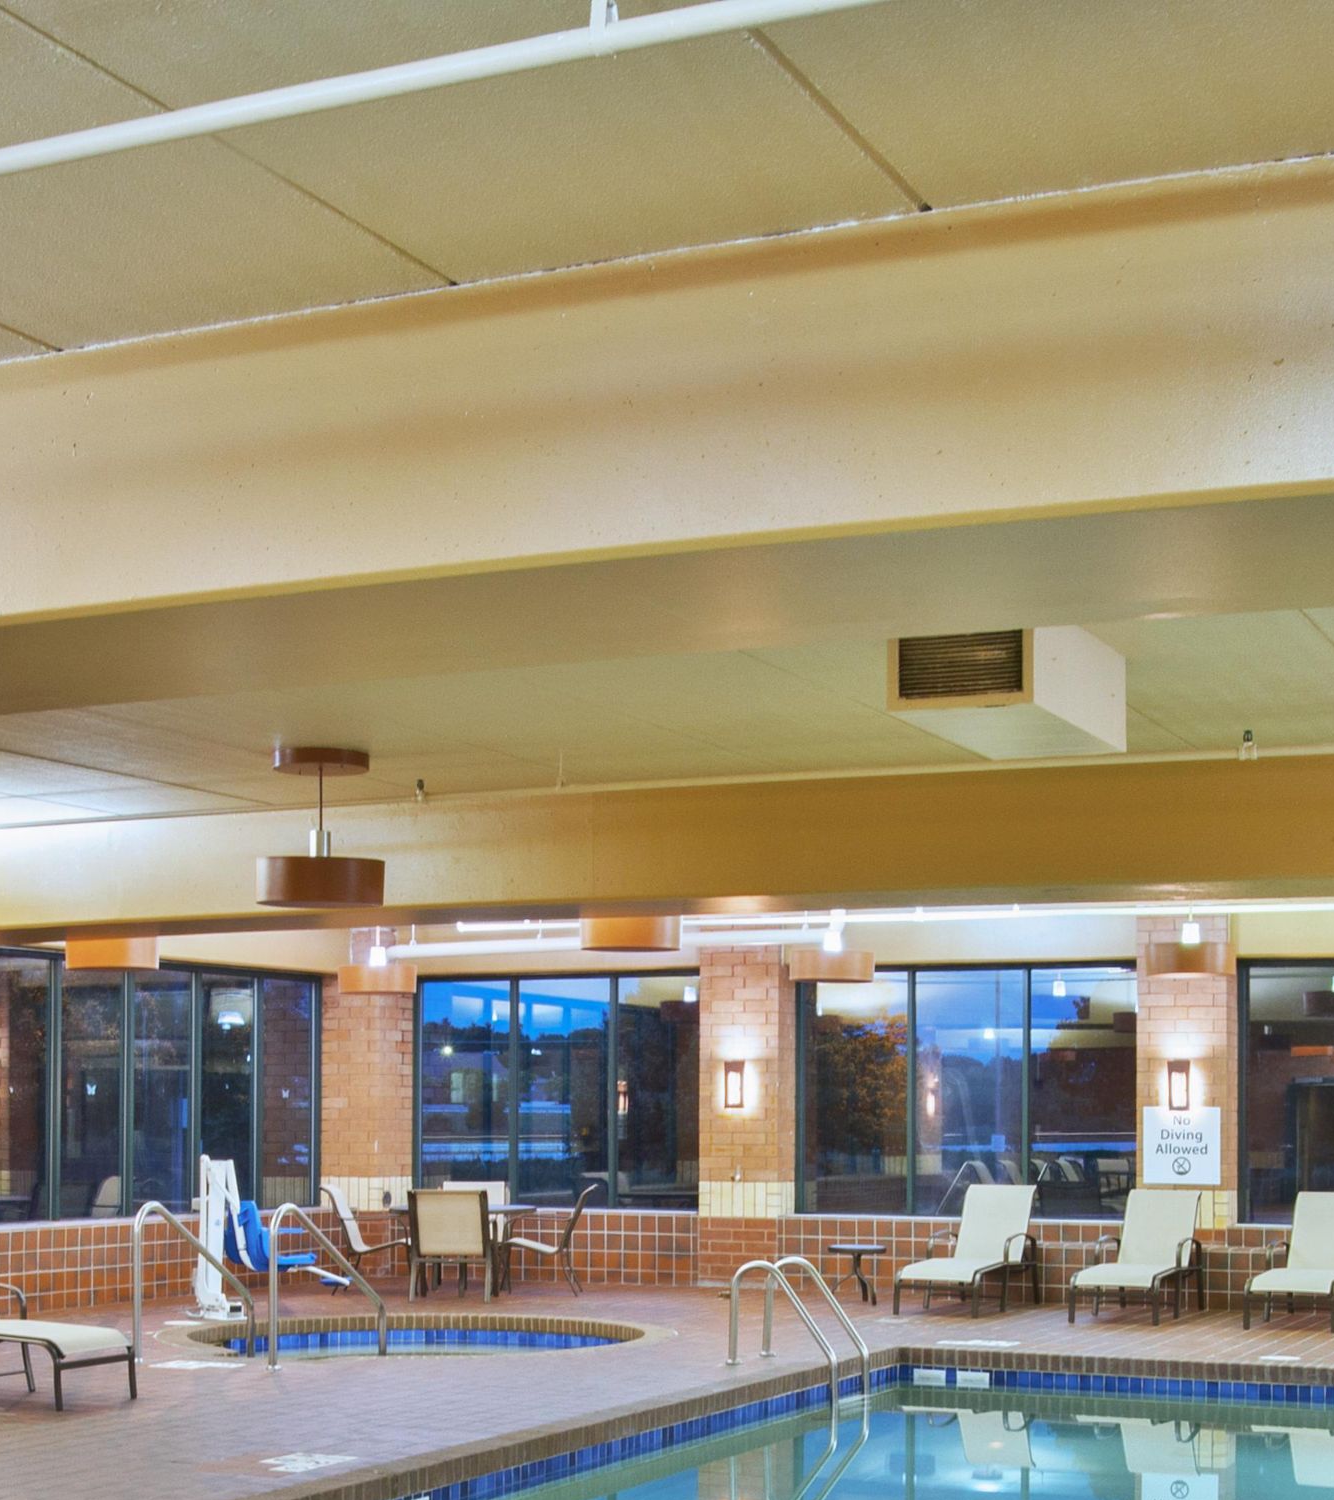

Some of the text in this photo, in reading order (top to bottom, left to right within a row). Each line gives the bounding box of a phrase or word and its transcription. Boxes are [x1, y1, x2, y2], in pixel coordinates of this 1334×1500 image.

[1173, 1115, 1191, 1125] No
[1160, 1129, 1203, 1143] Diving
[1155, 1144, 1208, 1155] Allowed
